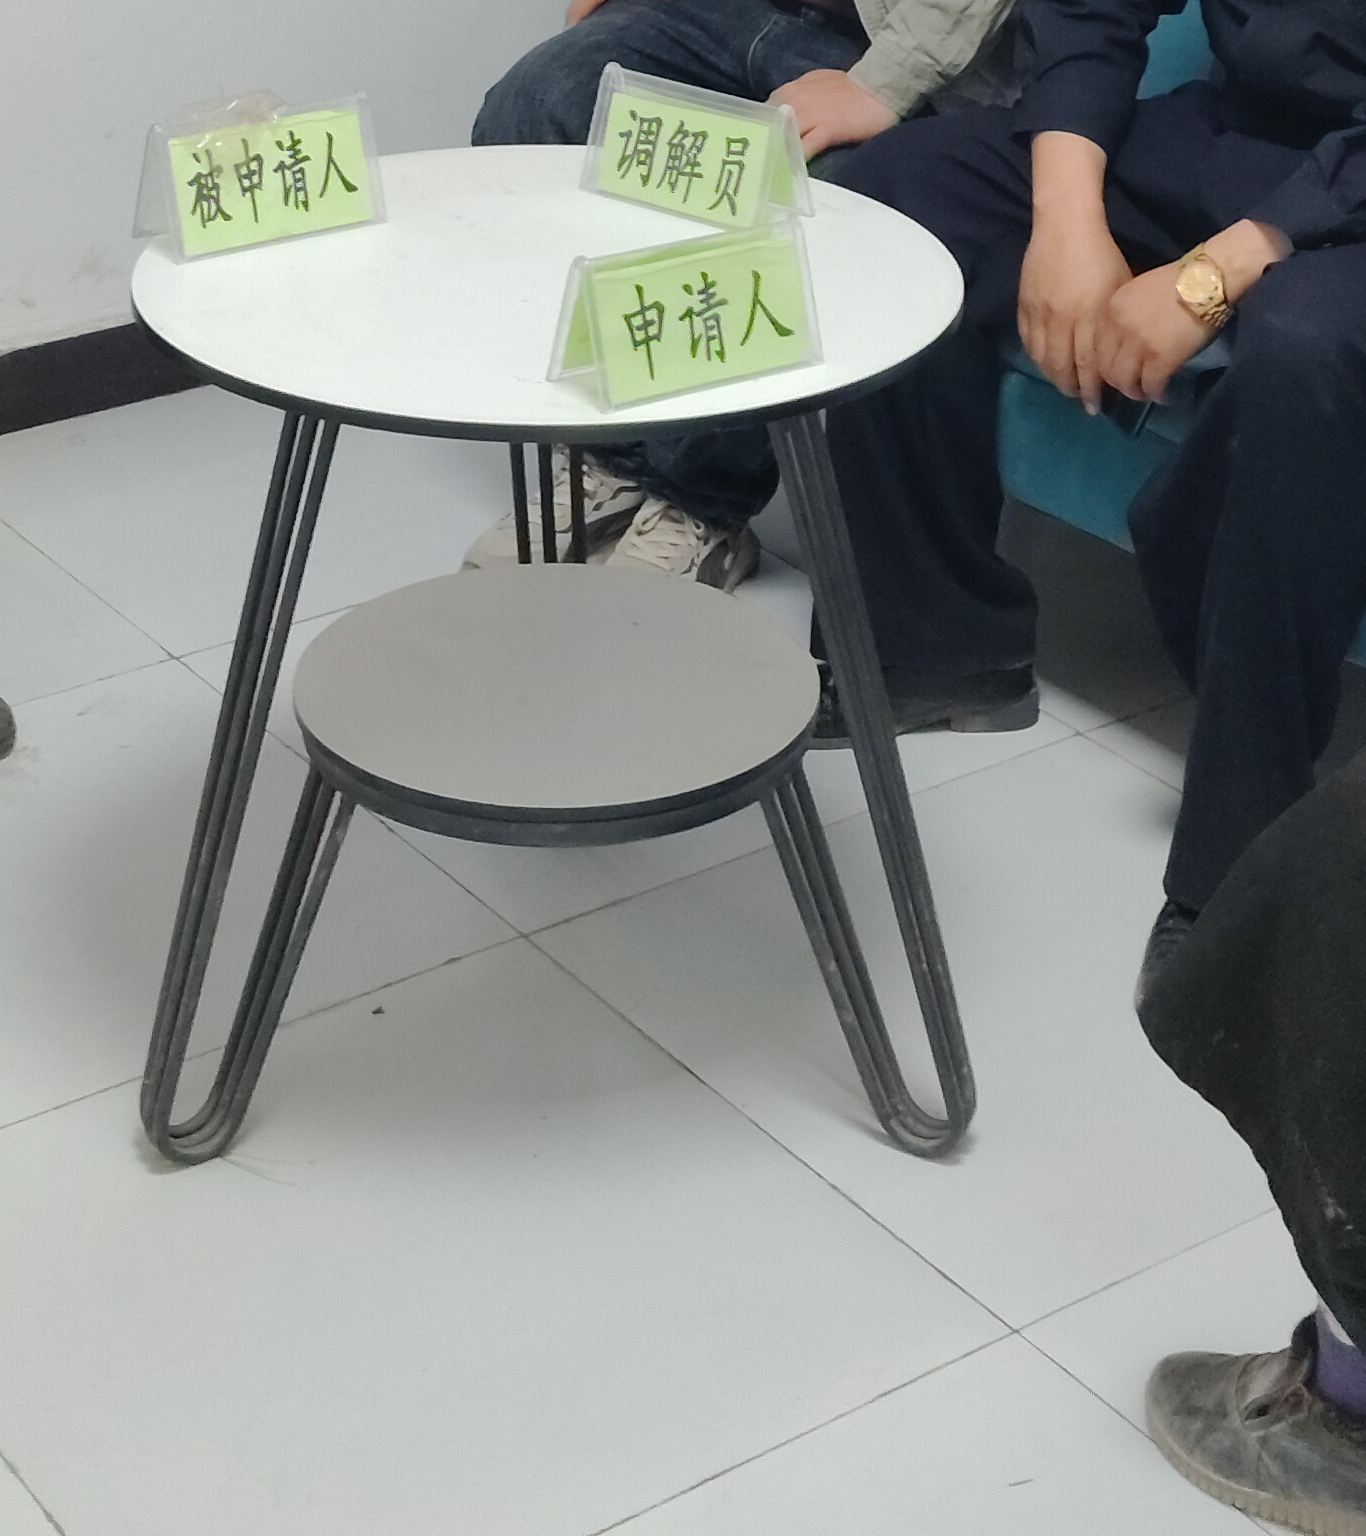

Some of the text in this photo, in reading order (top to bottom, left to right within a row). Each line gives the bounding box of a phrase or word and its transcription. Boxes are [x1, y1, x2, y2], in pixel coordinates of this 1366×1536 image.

[188, 131, 357, 230] 被申请人
[617, 109, 750, 216] 调解员
[622, 270, 794, 380] 申请人
